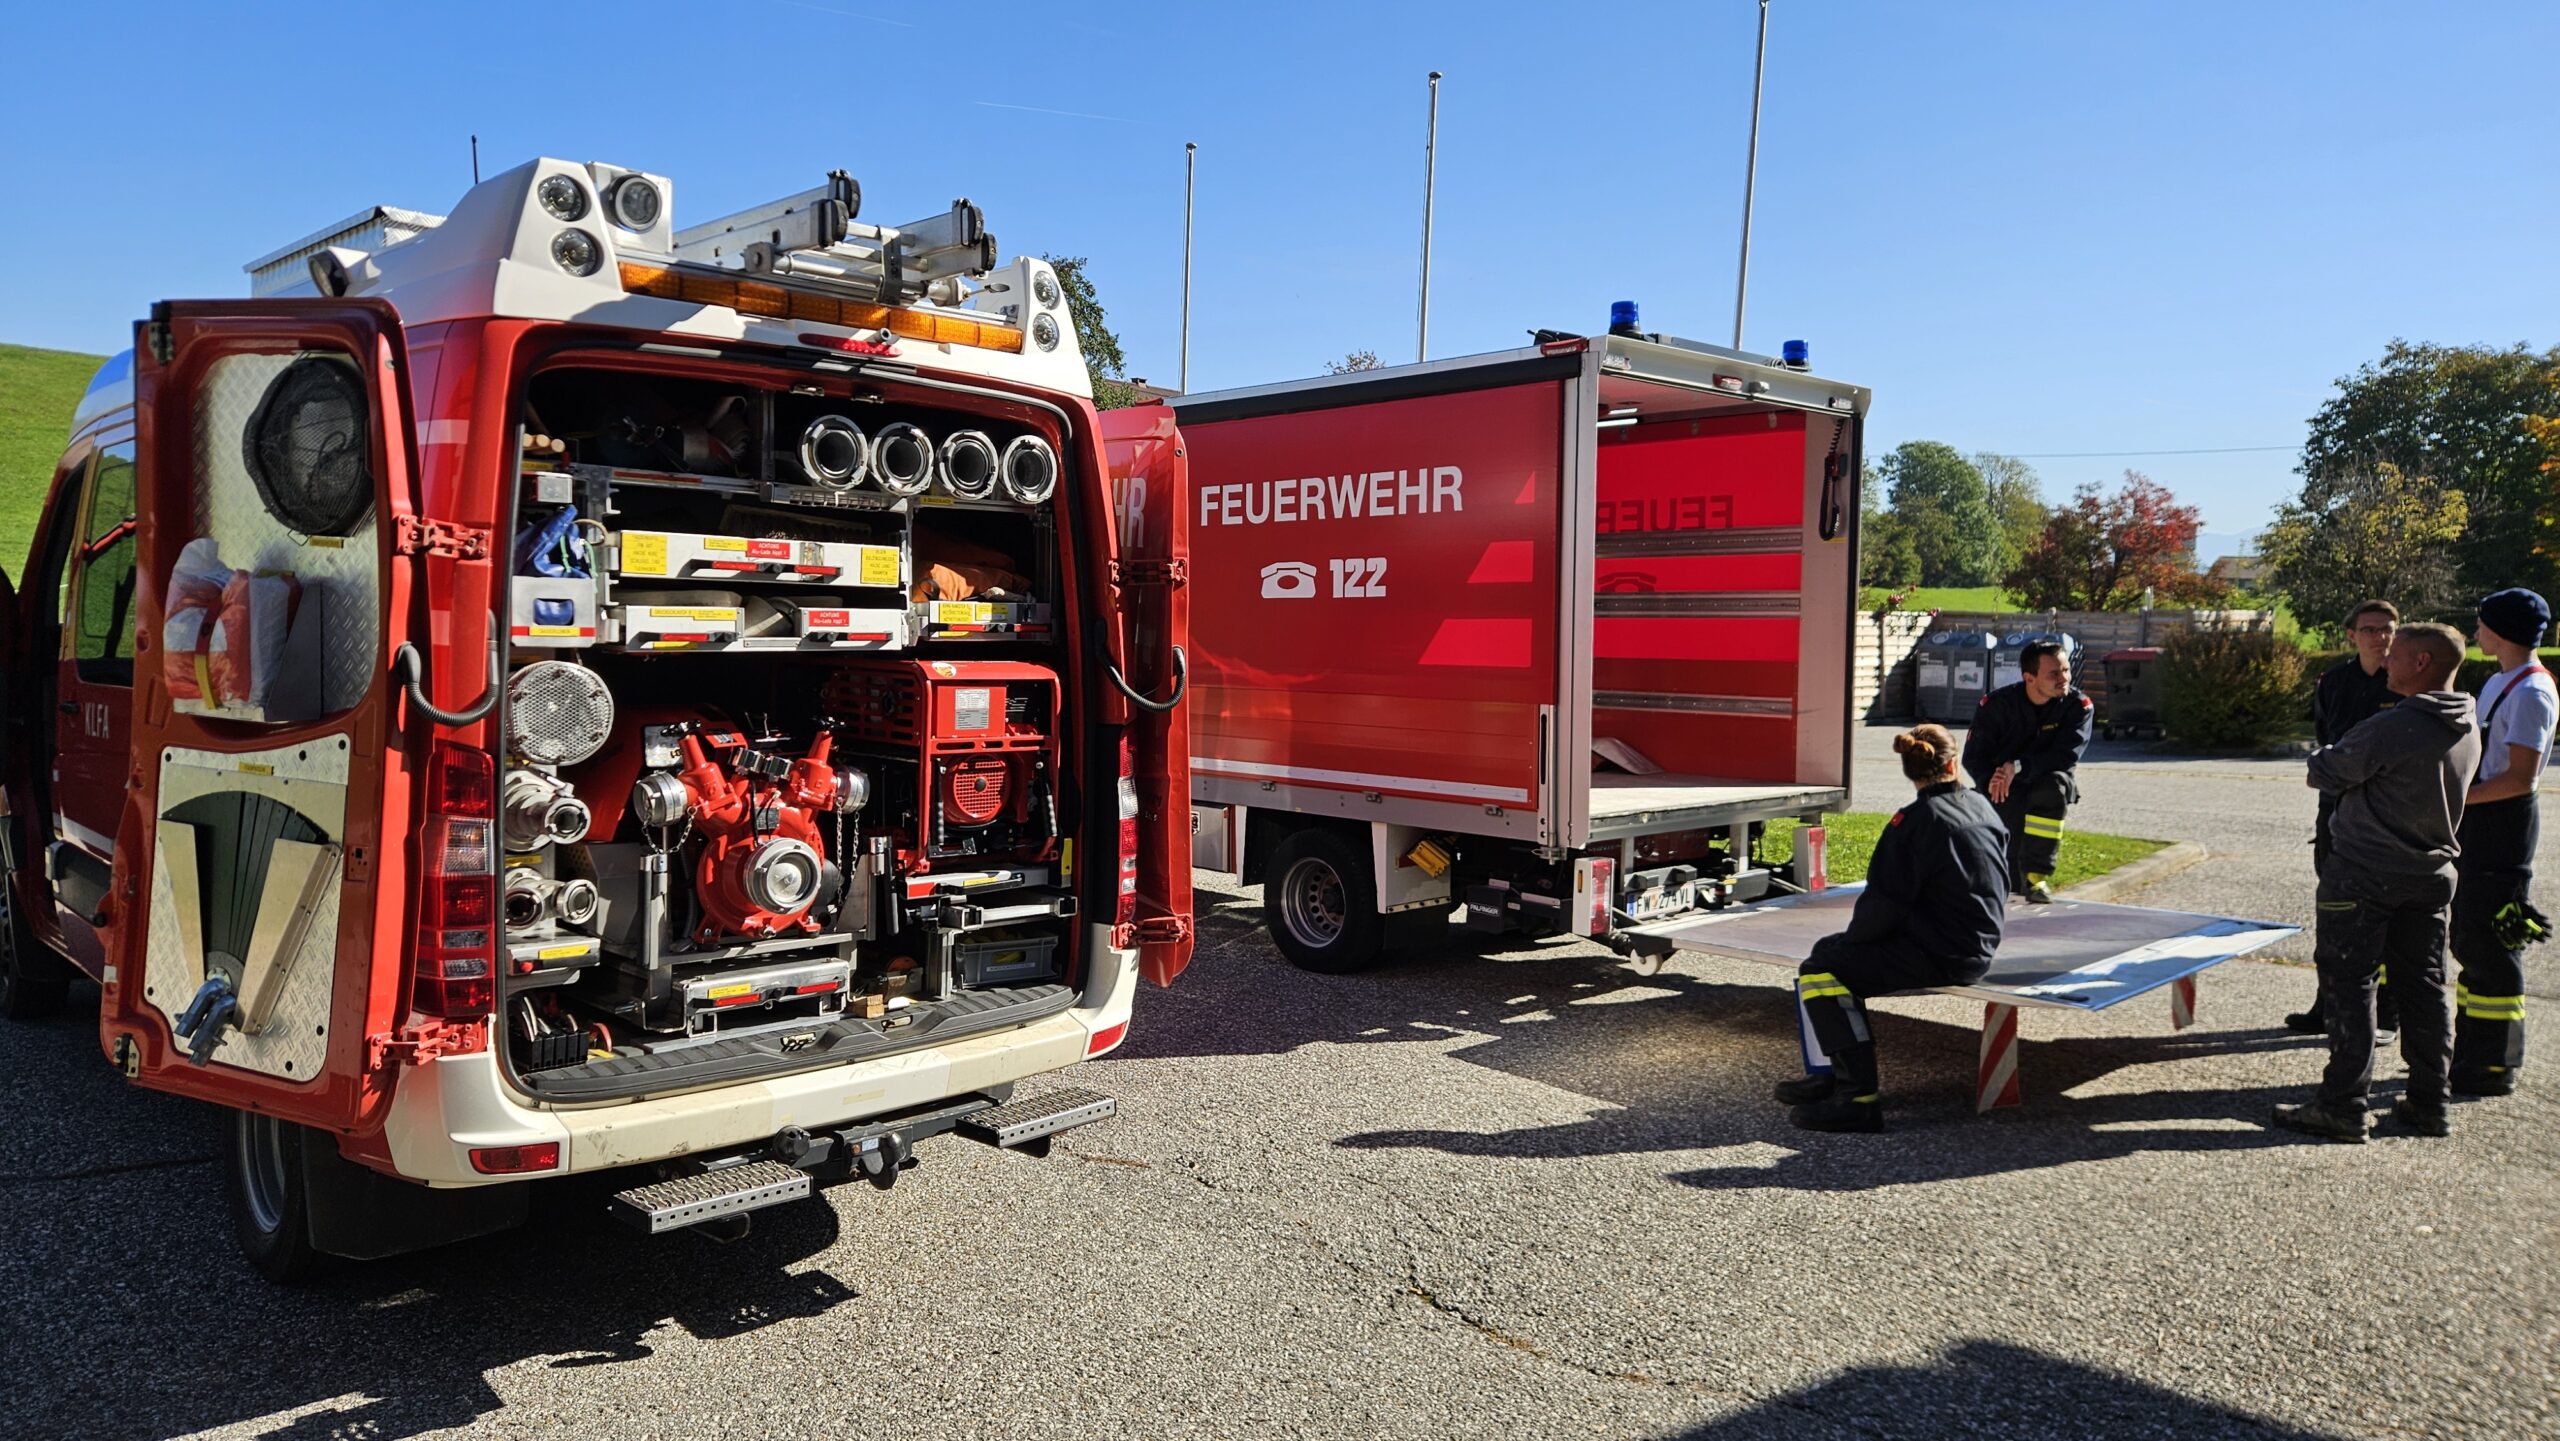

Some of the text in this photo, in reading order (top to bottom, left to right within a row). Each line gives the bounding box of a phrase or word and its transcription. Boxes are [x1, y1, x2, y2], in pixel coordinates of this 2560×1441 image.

[1200, 465, 1463, 527] FEUERWEHR
[1329, 557, 1387, 598] 122
[84, 702, 110, 739] KLFA
[1469, 903, 1498, 915] PALFINGER
